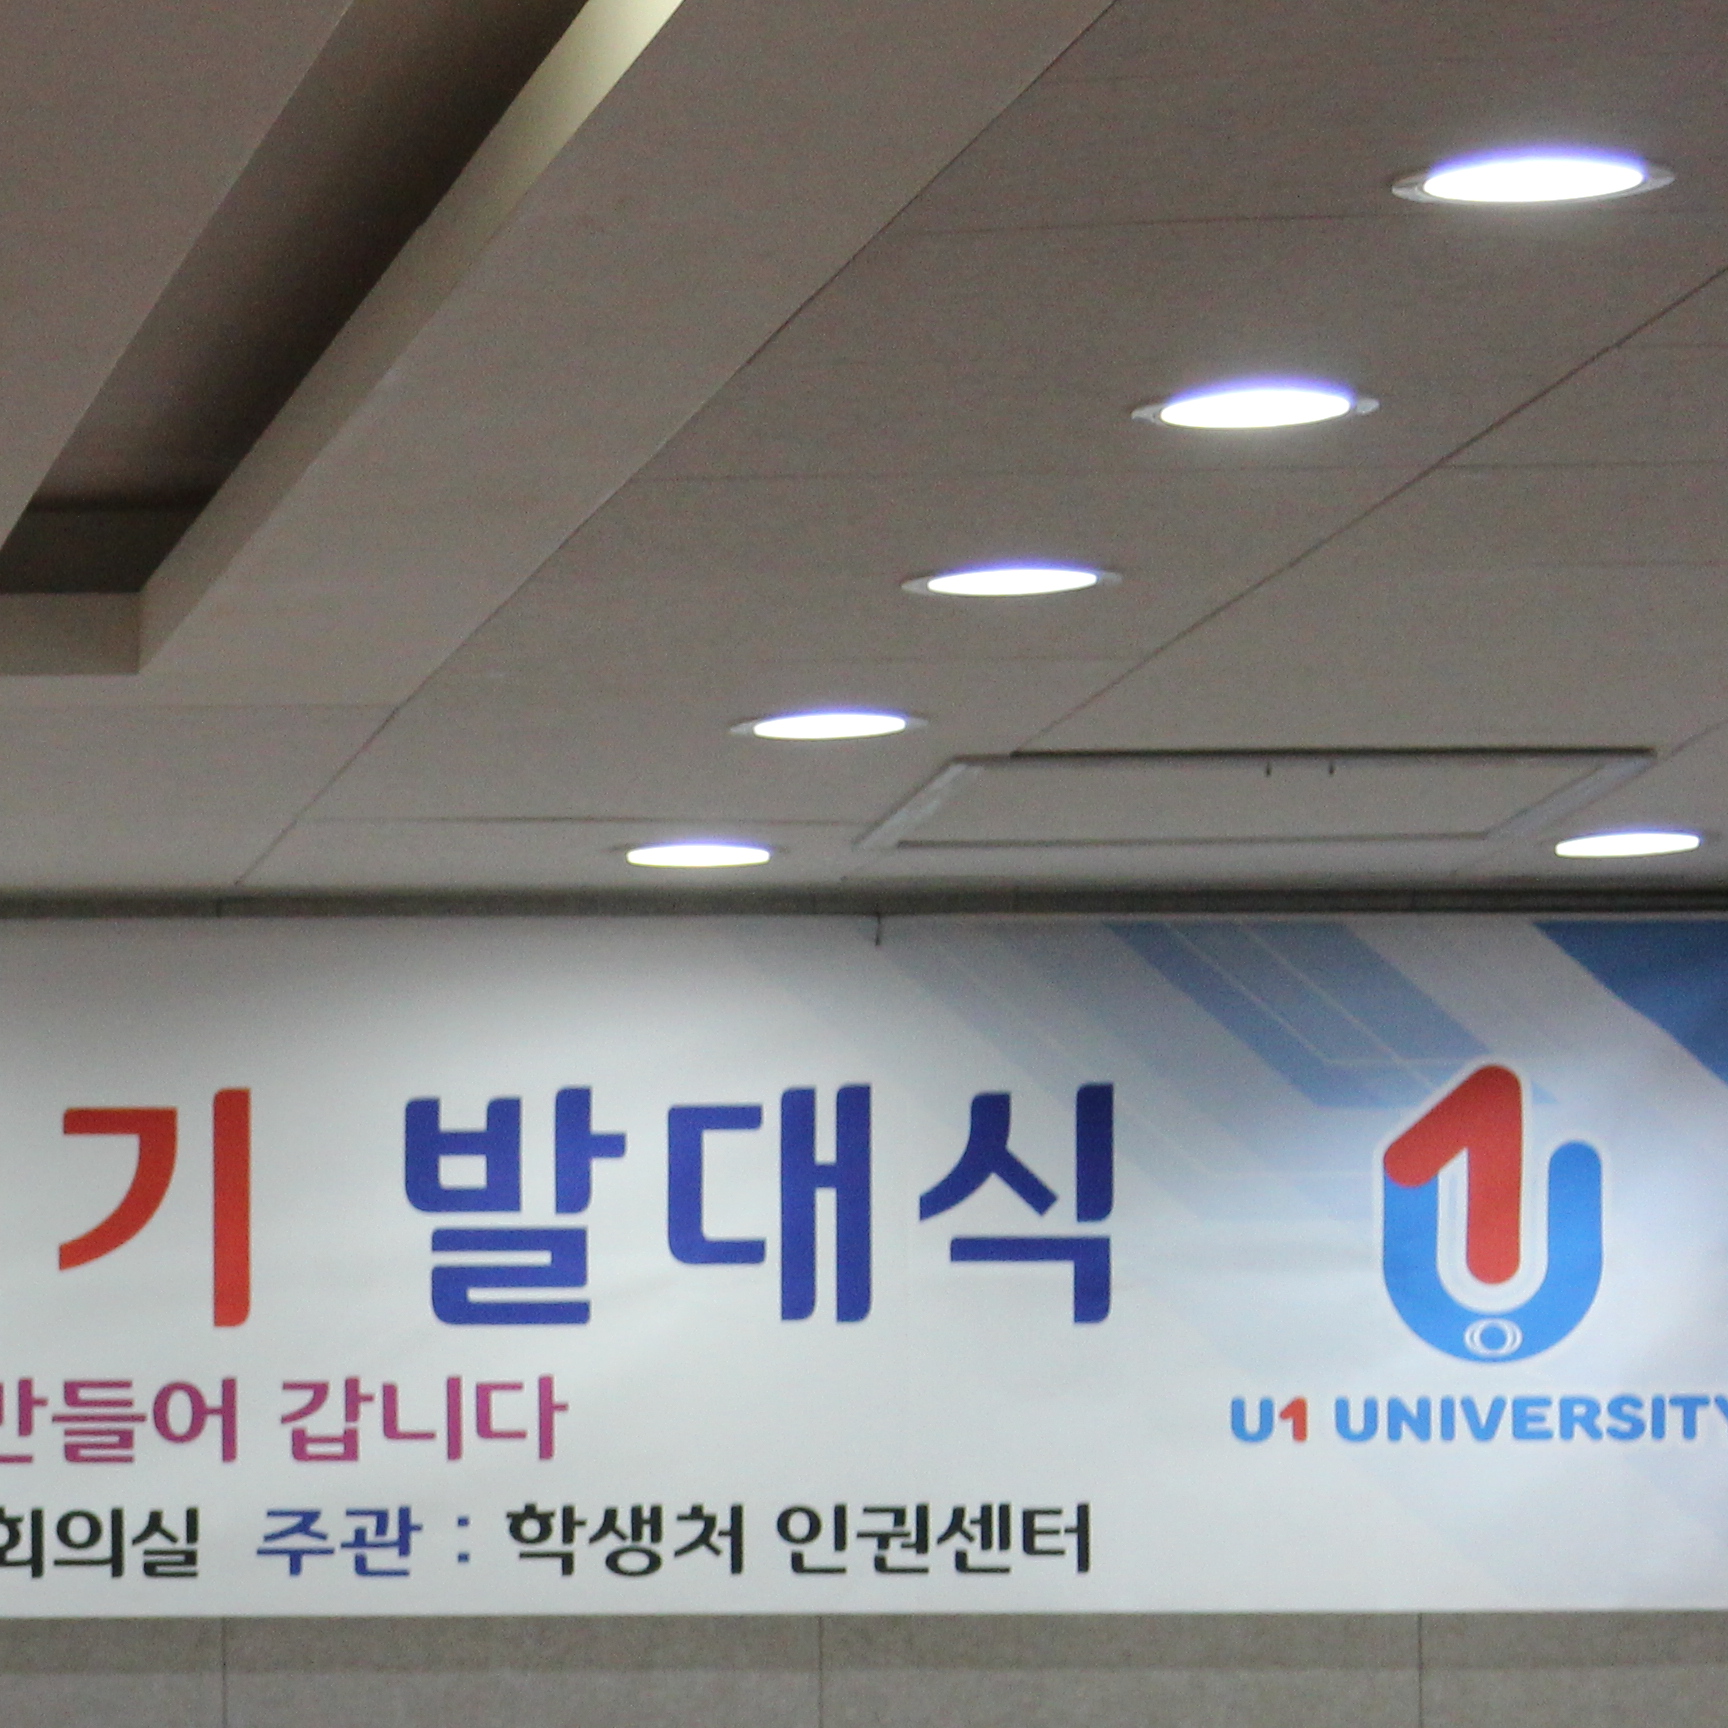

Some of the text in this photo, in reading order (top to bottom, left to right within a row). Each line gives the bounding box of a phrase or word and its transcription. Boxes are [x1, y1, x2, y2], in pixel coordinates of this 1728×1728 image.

[404, 1080, 1117, 1326] 발대식
[281, 1376, 567, 1462] 갑니다
[1230, 1395, 1308, 1443] U1
[506, 1502, 744, 1578] 학생처
[775, 1502, 1091, 1575] 인권센터
